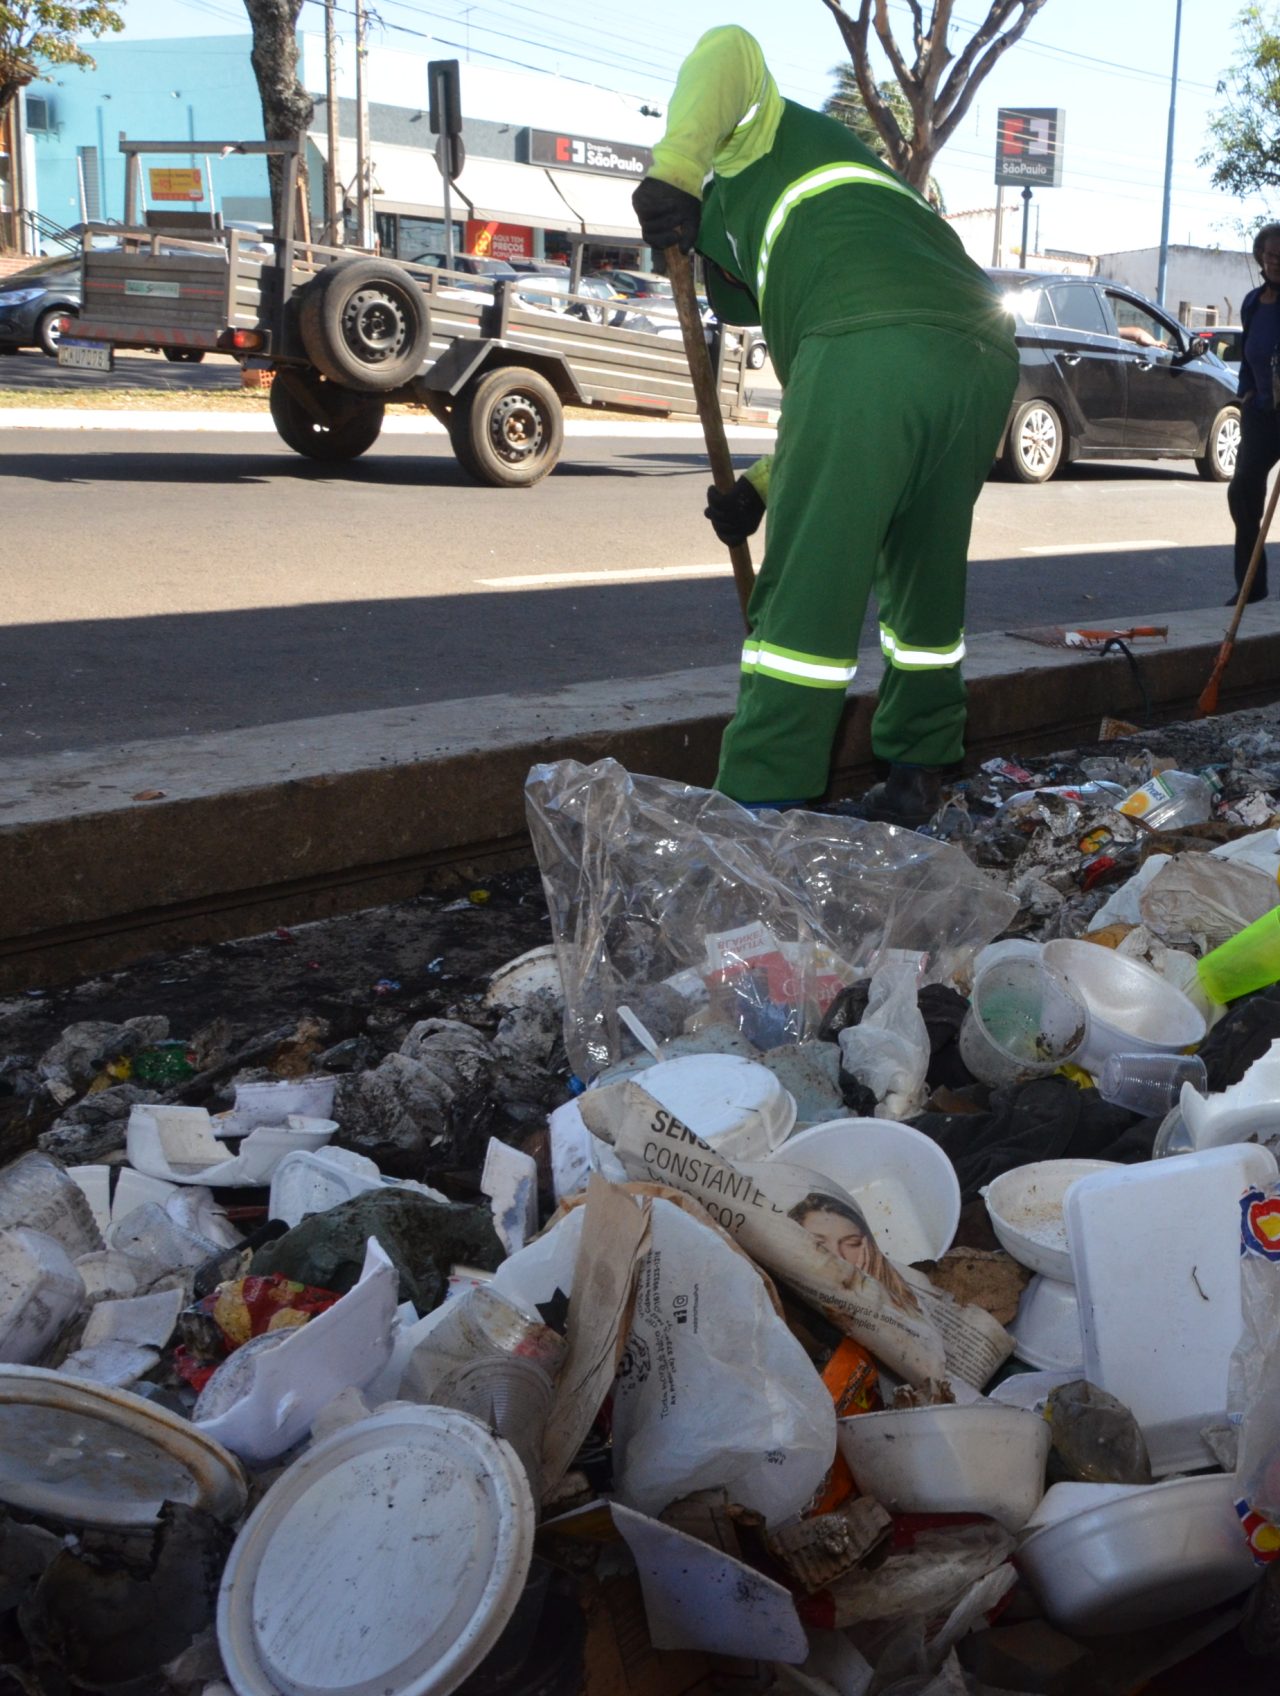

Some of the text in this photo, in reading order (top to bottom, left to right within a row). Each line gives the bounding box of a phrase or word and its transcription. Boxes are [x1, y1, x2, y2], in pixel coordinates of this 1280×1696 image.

[587, 150, 644, 172] SãoPaulo
[1002, 162, 1047, 175] SãoPaulo
[643, 1142, 767, 1208] CONSTANTE
[819, 1292, 847, 1308] podem
